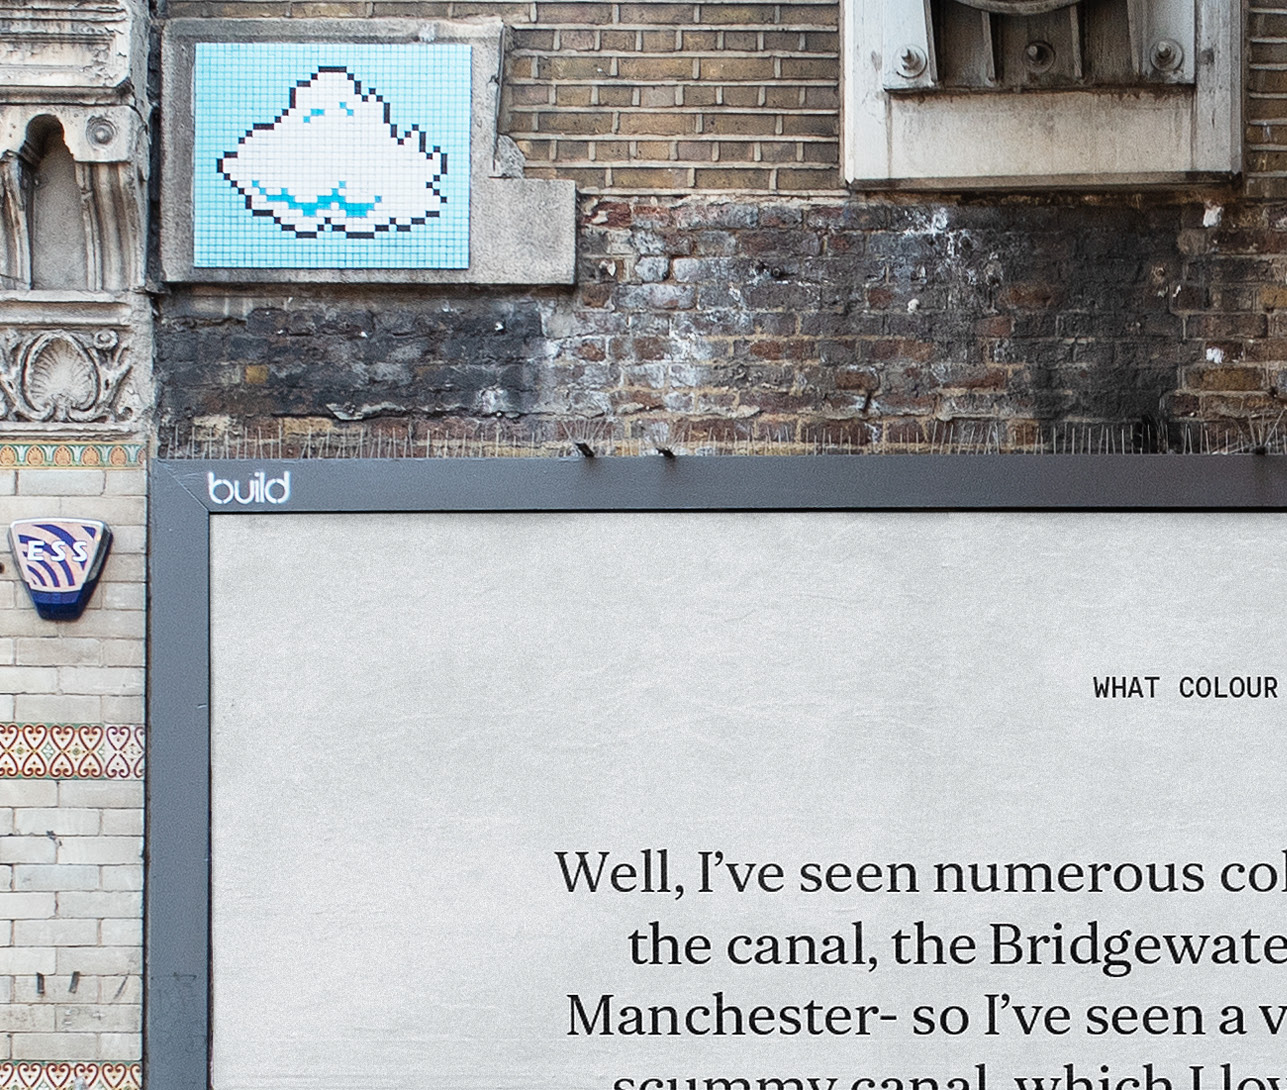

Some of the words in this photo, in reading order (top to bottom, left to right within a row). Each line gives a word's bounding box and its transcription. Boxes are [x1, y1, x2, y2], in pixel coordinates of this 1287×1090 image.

[207, 471, 290, 504] build
[27, 540, 88, 562] ESS
[1095, 678, 1160, 698] WHAT
[1181, 678, 1278, 699] COLOUR
[556, 850, 684, 900] Well,
[700, 853, 784, 893] I’ve
[802, 865, 920, 893] seen
[935, 865, 1205, 893] numerous
[629, 922, 711, 965] the
[729, 922, 878, 973] canal,
[893, 922, 976, 965] the
[569, 993, 897, 1036] Manchester-
[915, 1007, 969, 1035] so
[988, 995, 1071, 1035] I’ve
[1088, 1007, 1204, 1035] seen
[1221, 1007, 1247, 1035] a
